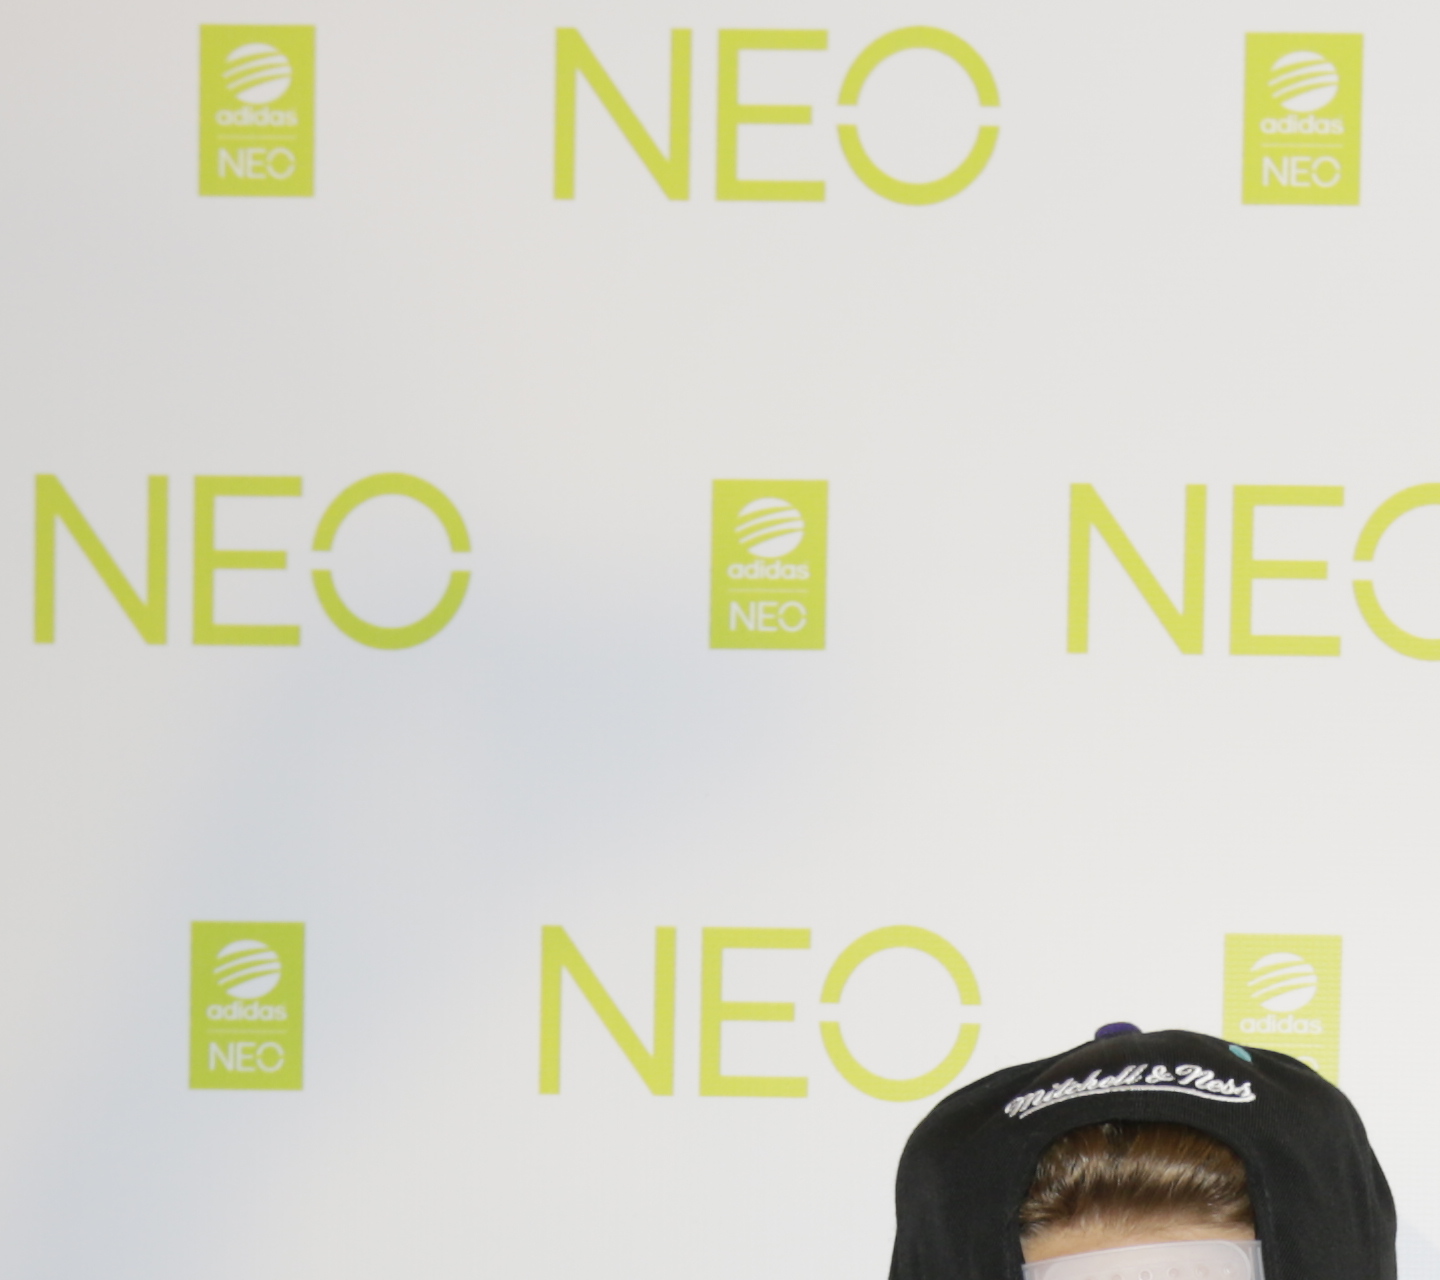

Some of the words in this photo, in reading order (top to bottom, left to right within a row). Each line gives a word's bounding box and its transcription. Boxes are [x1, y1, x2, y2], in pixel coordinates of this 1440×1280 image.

[215, 104, 297, 126] adidas
[554, 26, 999, 205] NEO
[1260, 112, 1344, 134] adidas
[217, 145, 294, 179] NEO
[1262, 153, 1341, 187] NEO
[35, 472, 470, 650] NEO
[727, 558, 809, 578] adidas
[729, 598, 806, 631] NEO
[206, 999, 286, 1020] adidas
[540, 925, 980, 1101] NEO
[1240, 1013, 1323, 1034] adidas
[208, 1040, 284, 1072] NEO
[1004, 1063, 1148, 1117] Mitchell
[1145, 1065, 1175, 1084] &
[1175, 1063, 1257, 1100] Ness
